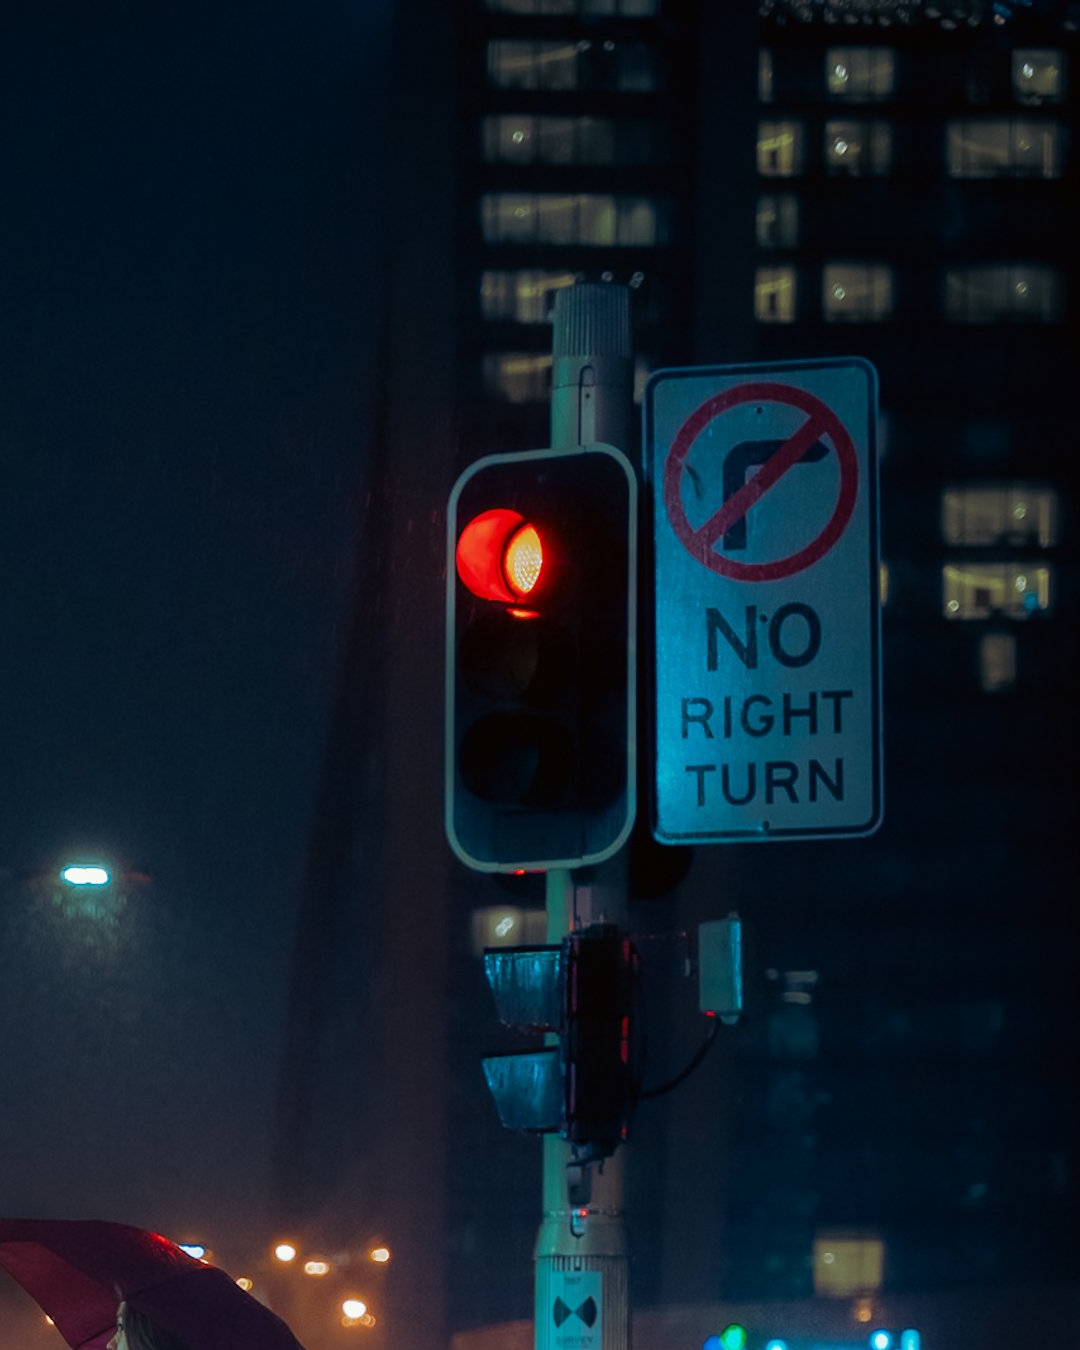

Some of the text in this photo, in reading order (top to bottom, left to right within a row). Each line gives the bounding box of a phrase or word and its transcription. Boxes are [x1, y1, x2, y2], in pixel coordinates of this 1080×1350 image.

[705, 602, 821, 671] NO
[681, 689, 854, 740] RIGHT
[685, 758, 844, 807] TURN
